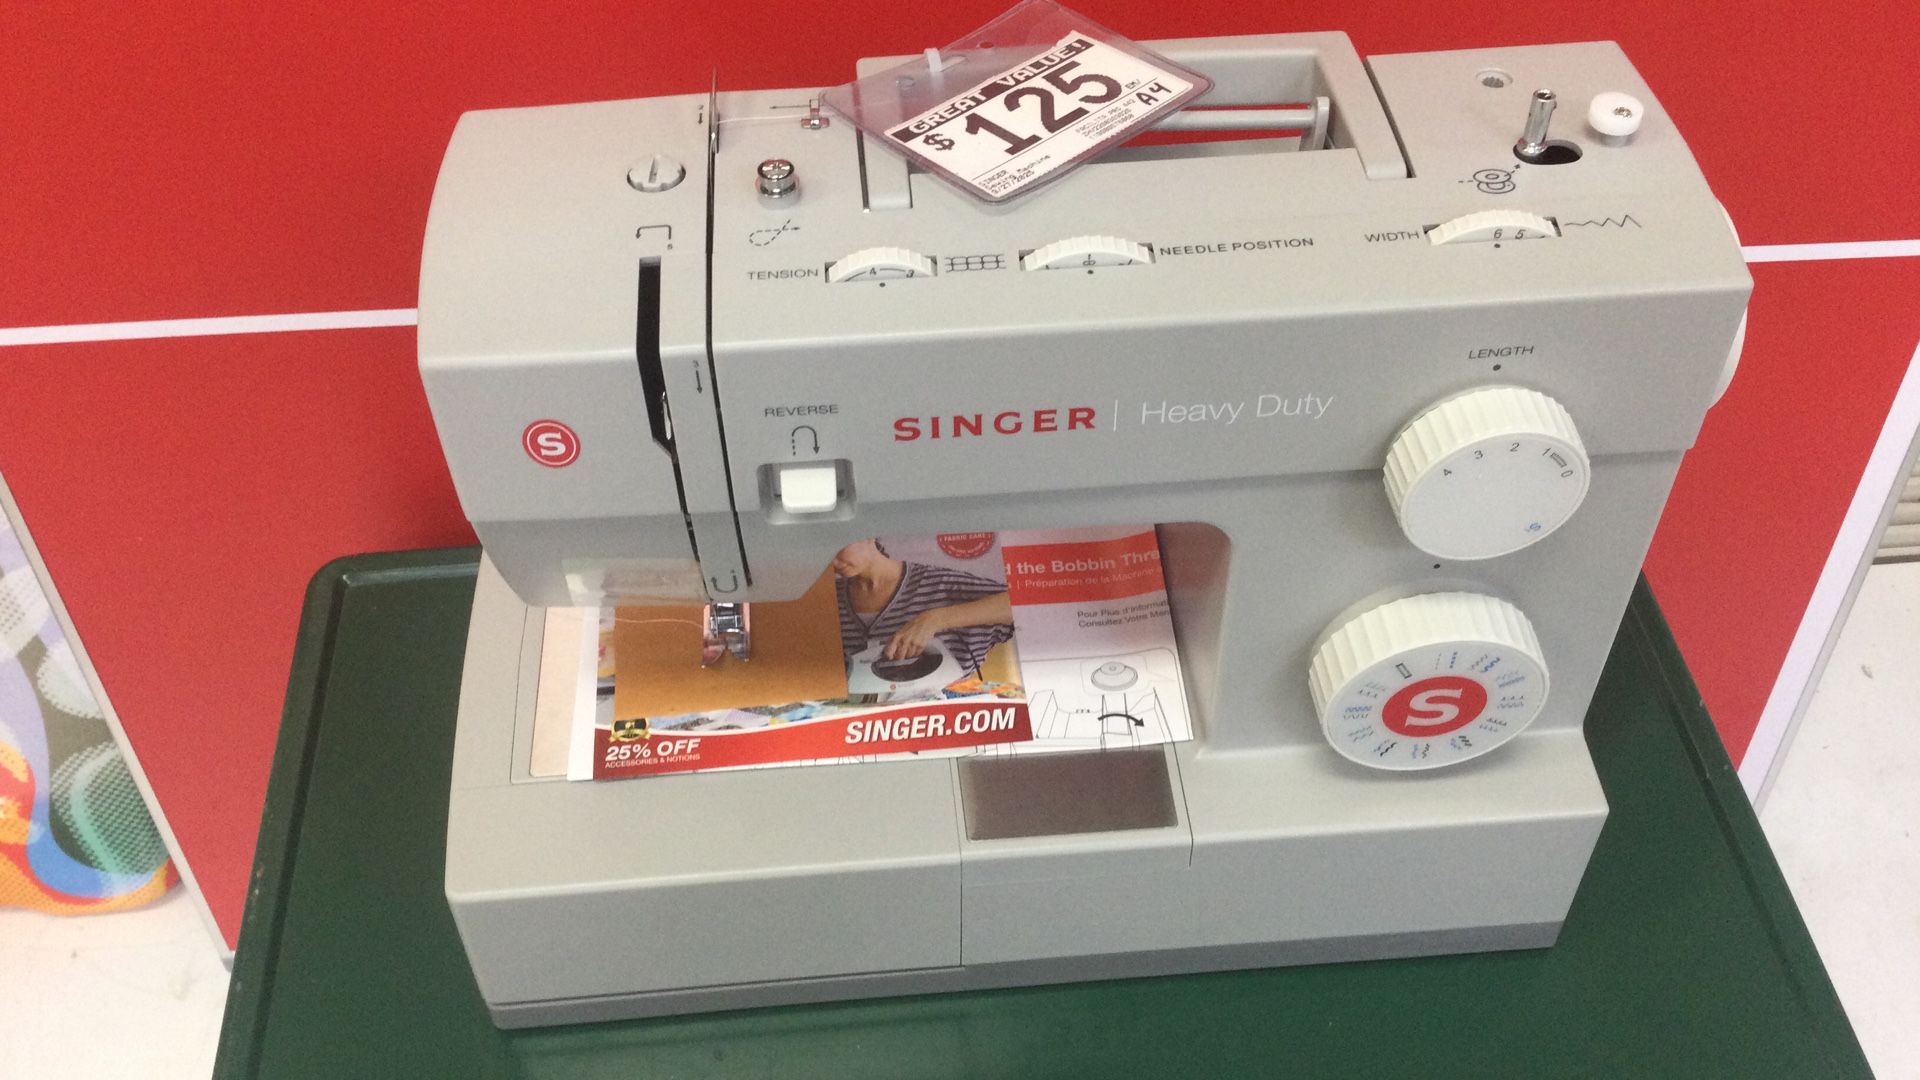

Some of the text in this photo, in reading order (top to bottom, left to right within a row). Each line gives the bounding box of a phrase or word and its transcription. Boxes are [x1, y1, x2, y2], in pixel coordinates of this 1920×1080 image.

[908, 42, 1086, 134] GREAT VALUE!
[1136, 82, 1172, 106] A4
[922, 132, 955, 151] $
[965, 60, 1122, 156] 125
[1364, 231, 1420, 243] WIDTH
[1493, 229, 1524, 239] 6 5
[1160, 238, 1314, 256] NEEDLE POSITION
[747, 269, 818, 280] TENSION
[869, 267, 915, 278] 4 3
[1468, 345, 1534, 359] LENGTH
[764, 404, 839, 418] REVERSE
[894, 393, 1336, 442] SINGER Heavy Duty
[537, 431, 566, 456] S
[1474, 450, 1484, 460] 3
[1509, 442, 1520, 453] 2
[1016, 561, 1046, 574] the
[1051, 556, 1116, 573] Bobbin
[1120, 550, 1161, 566] Thre
[1024, 577, 1085, 589] Préparation
[1085, 577, 1098, 585] de
[1077, 610, 1098, 618] Pour
[1100, 608, 1120, 616] Plus
[1078, 618, 1122, 628] Consultez
[1405, 688, 1463, 728] S
[845, 707, 1016, 744] SINGER.COM
[605, 738, 701, 761] 25% OFF
[604, 757, 658, 768] ACCESSORIES
[667, 753, 700, 763] NOTIONS
